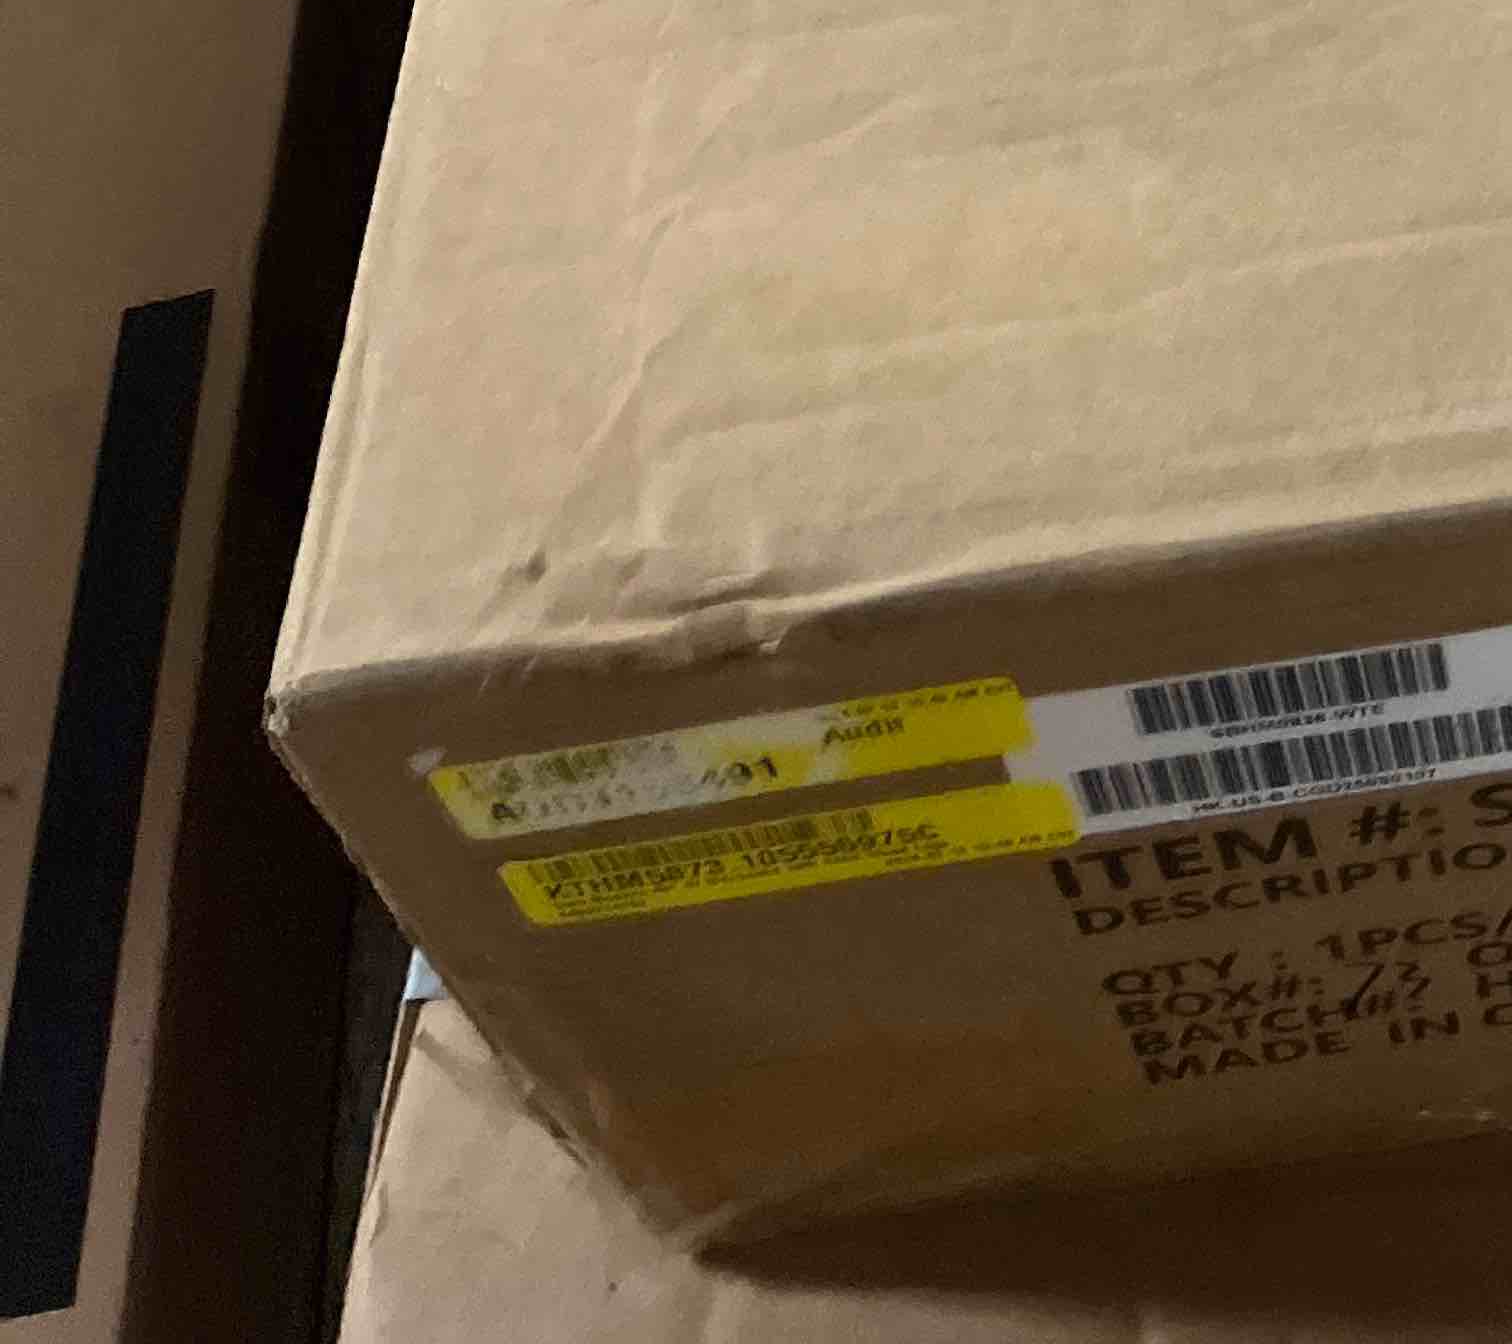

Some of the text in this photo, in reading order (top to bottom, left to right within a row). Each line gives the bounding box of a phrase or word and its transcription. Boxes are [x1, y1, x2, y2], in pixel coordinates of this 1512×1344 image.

[1048, 816, 1318, 900] ITEM
[1350, 805, 1446, 847] #:
[1102, 951, 1240, 997] QTY
[1142, 1030, 1352, 1086] MADE
[1389, 1011, 1461, 1044] IN
